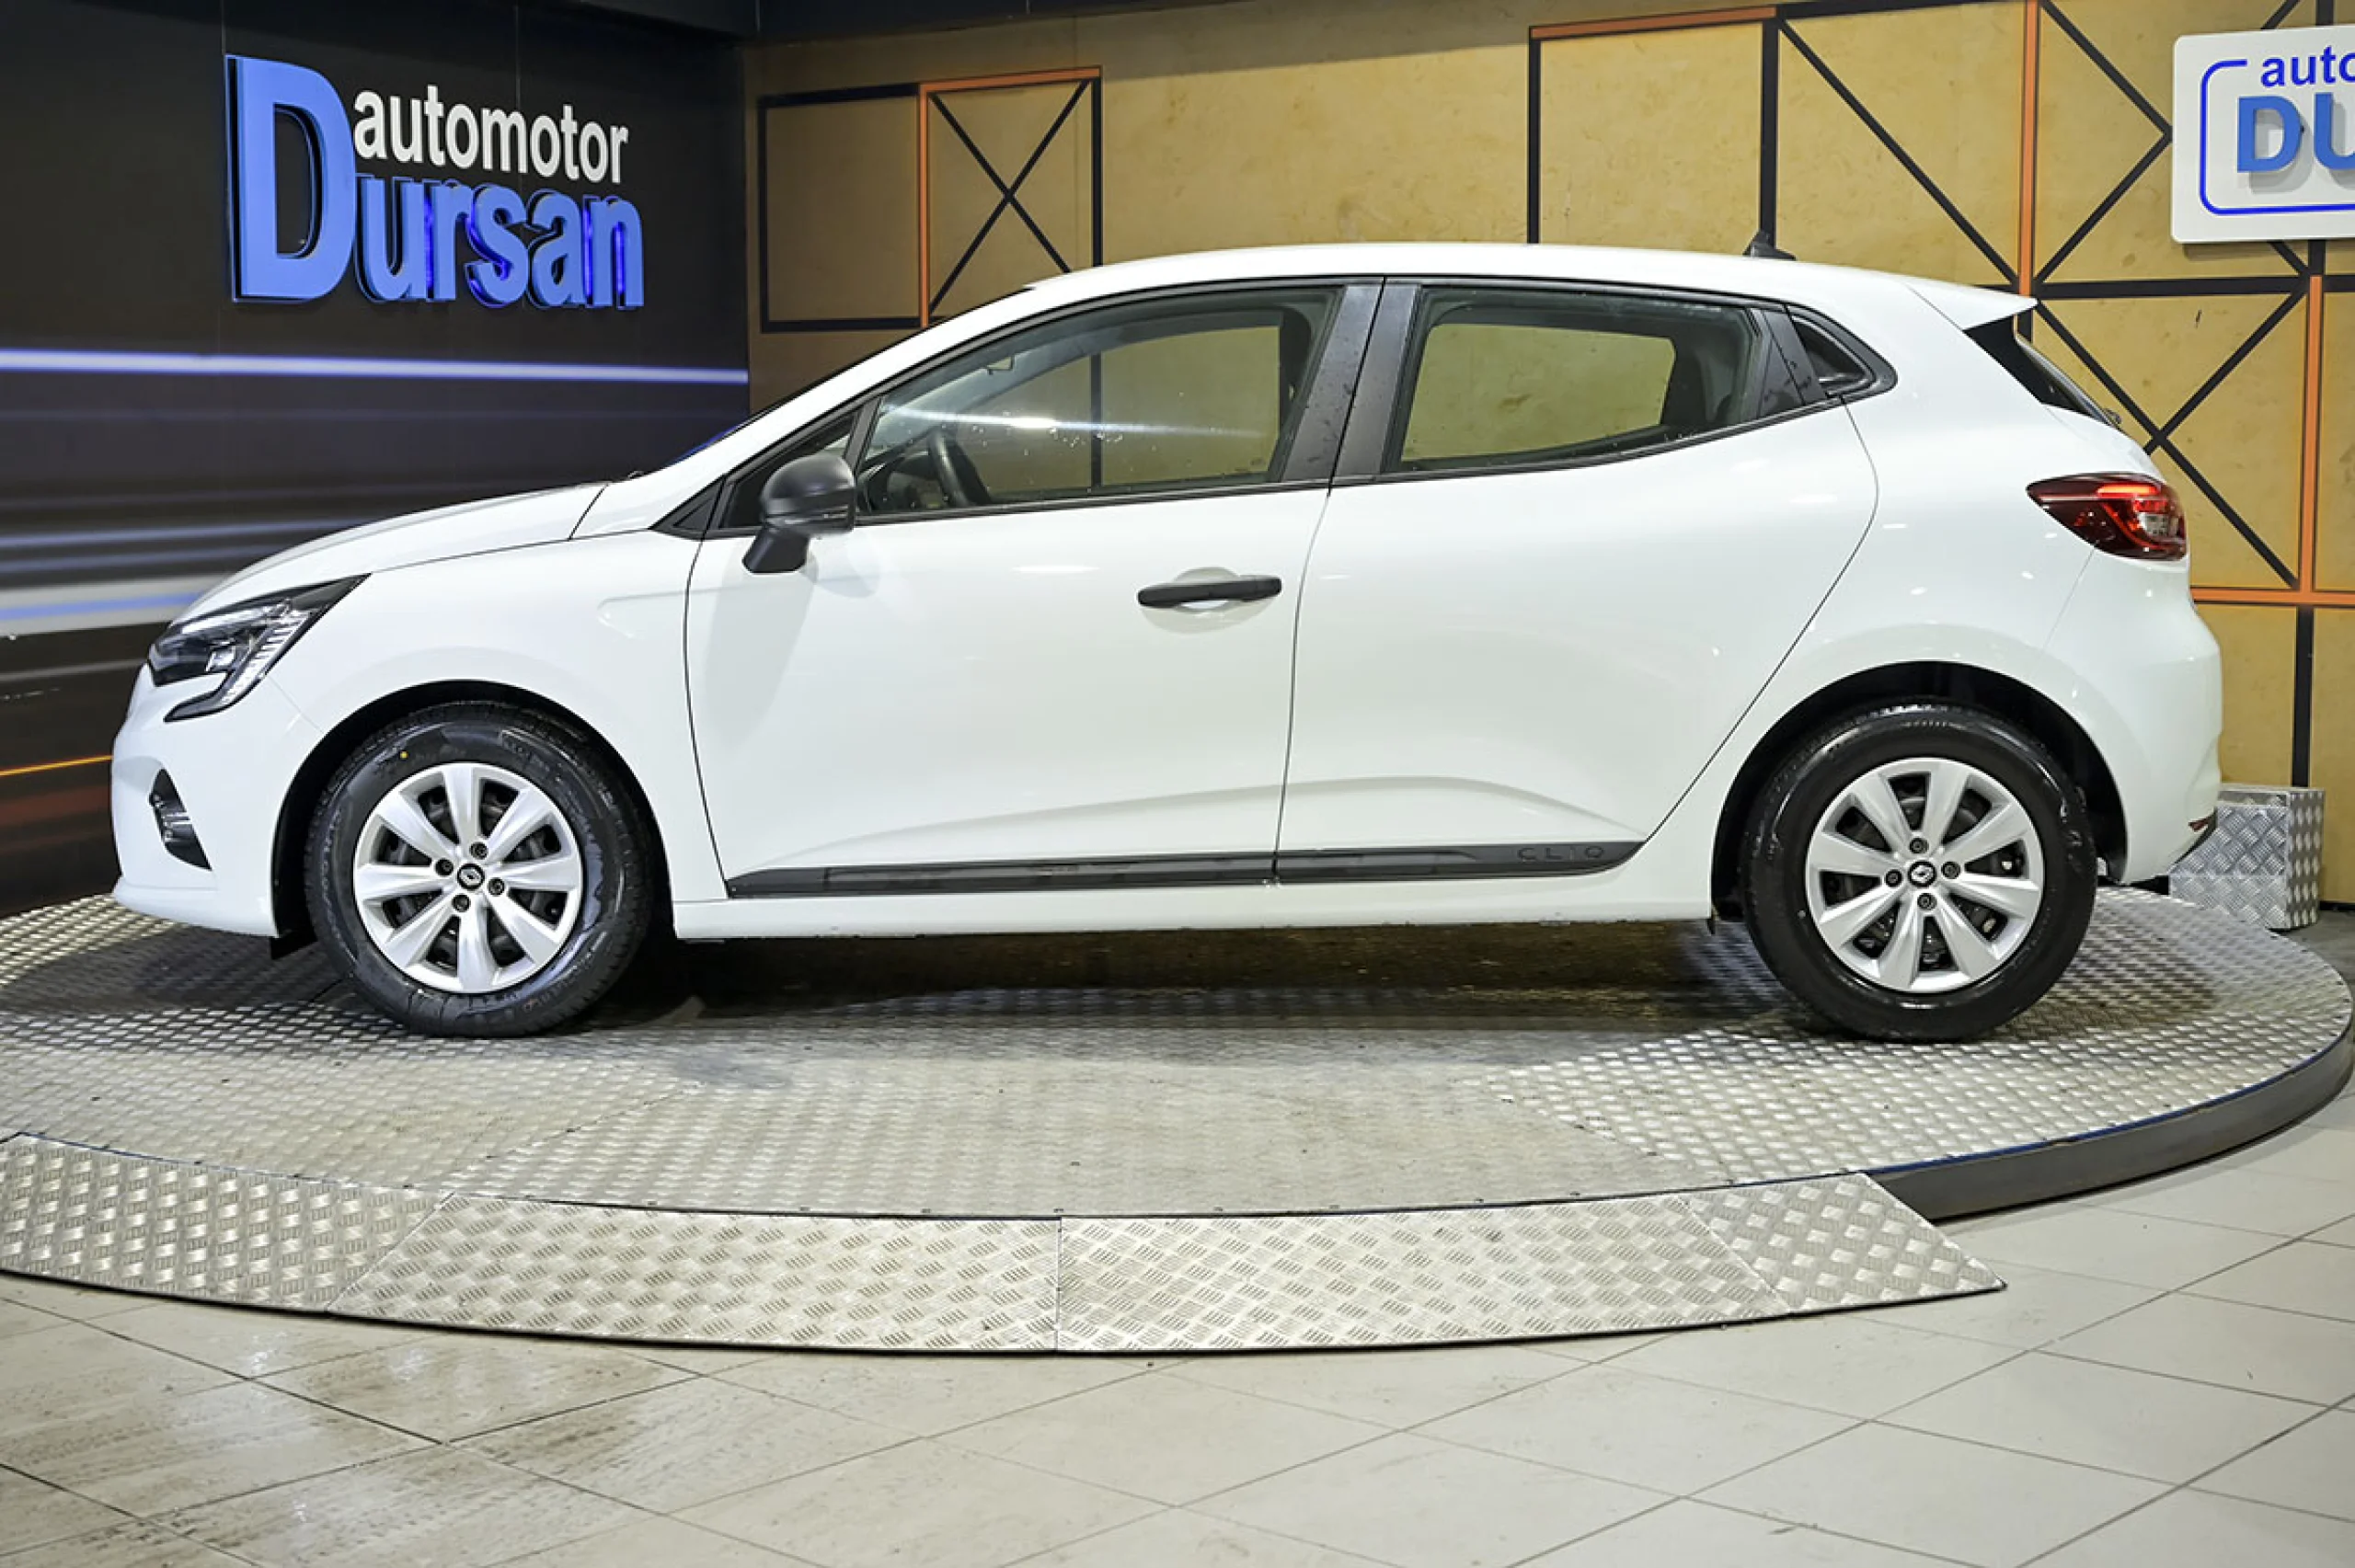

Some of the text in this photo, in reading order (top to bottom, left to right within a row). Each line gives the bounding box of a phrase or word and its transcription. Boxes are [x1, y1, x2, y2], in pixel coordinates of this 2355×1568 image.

[225, 54, 644, 309] Dursan
[353, 84, 629, 184] automotor
[1518, 845, 1604, 860] CLIO
